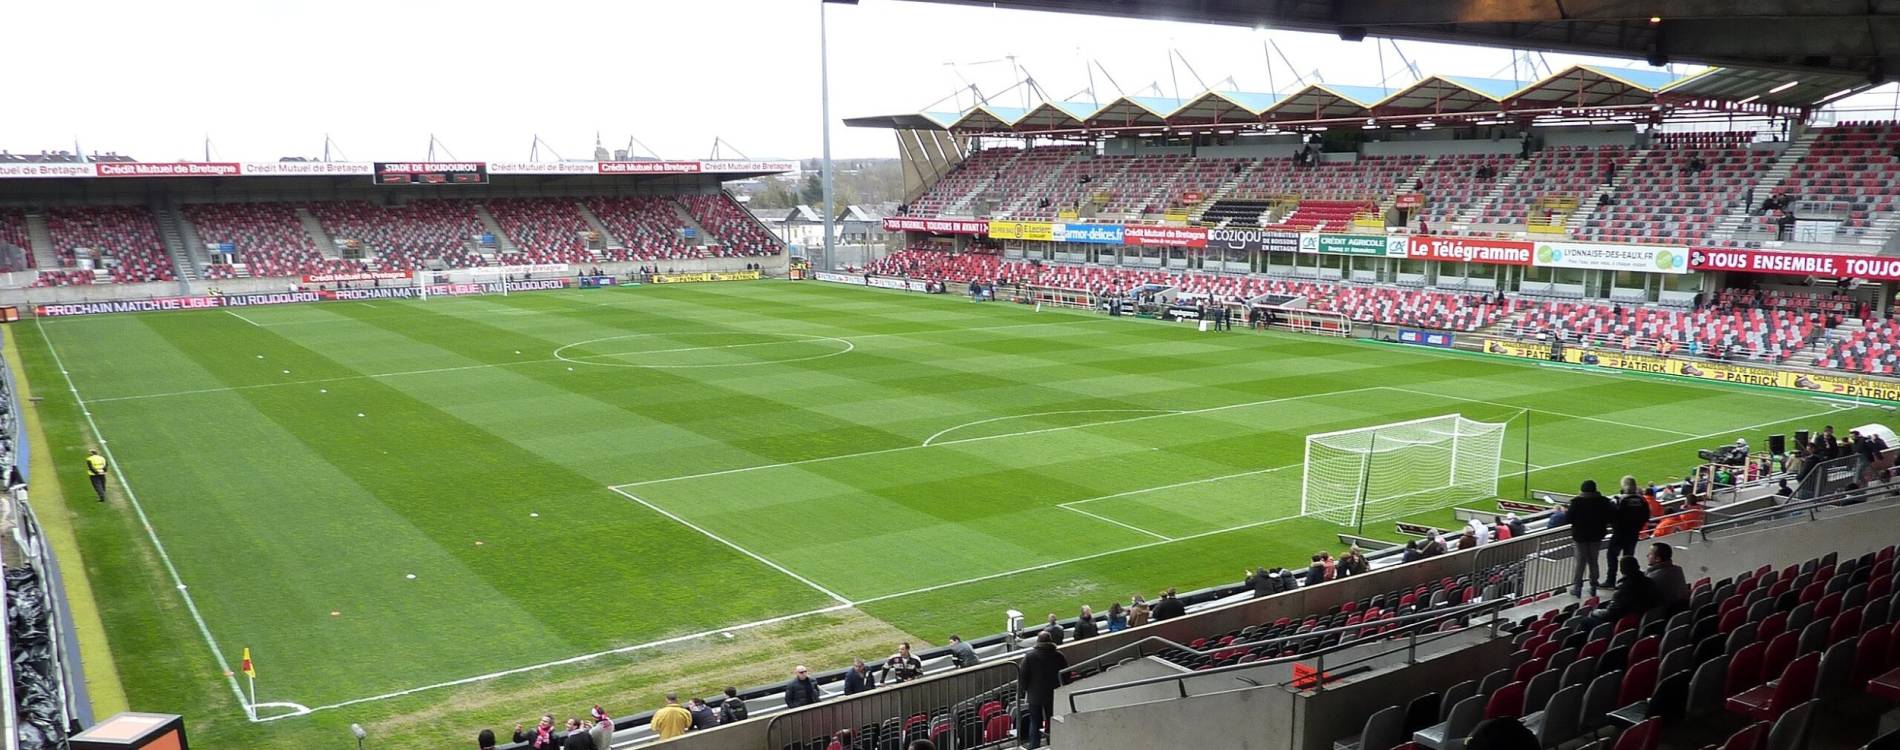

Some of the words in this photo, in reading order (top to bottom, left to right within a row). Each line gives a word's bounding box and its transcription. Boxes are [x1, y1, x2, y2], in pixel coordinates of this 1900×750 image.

[23, 166, 37, 175] de
[40, 165, 90, 176] Bretagne
[101, 164, 136, 174] Crédit
[137, 163, 173, 174] Mutuel
[174, 163, 188, 173] de
[190, 163, 236, 175] Bretagne
[247, 163, 278, 173] Crédit
[280, 163, 311, 173] Mutuel
[313, 163, 325, 172] de
[328, 163, 369, 174] Bretagne
[384, 163, 411, 172] STADE
[412, 163, 424, 172] DE
[426, 163, 477, 172] ROUDOUROU
[491, 163, 517, 172] Crédit
[518, 163, 545, 172] Mutuel
[547, 162, 558, 171] de
[559, 162, 594, 173] Bretagne
[601, 162, 626, 172] Crédit
[627, 162, 652, 172] Mutuel
[653, 162, 663, 171] de
[664, 162, 698, 172] Bretagne
[705, 162, 726, 171] Crédit
[728, 162, 751, 171] Mutuel
[752, 162, 761, 170] de
[762, 162, 793, 171] Bretagne
[1065, 228, 1123, 241] armor-delices.fr
[1124, 228, 1143, 237] Crédit
[1144, 228, 1165, 237] Mutuel
[1166, 229, 1175, 238] de
[1175, 230, 1205, 240] Bretagne
[1321, 236, 1346, 246] CRÉDIT
[1349, 238, 1385, 247] AGRICOLE
[1411, 241, 1429, 256] Le
[1432, 240, 1530, 262] Télégramme
[1564, 249, 1654, 260] LYONNAISE-DES-EAUX.FR
[1708, 253, 1747, 269] TOUS
[1753, 255, 1838, 275] ENSEMBLE,
[1846, 259, 1900, 277] TOUJO
[335, 288, 391, 301] PROCHAIN
[393, 286, 432, 299] MATCH
[433, 285, 448, 295] DE
[448, 284, 480, 295] LIGUE
[488, 283, 503, 293] AU
[505, 280, 563, 293] ROUDOUROU
[46, 301, 112, 316] PROCHAIN
[114, 299, 160, 313] MATCH
[162, 299, 180, 310] DE
[181, 297, 219, 309] LIGUE
[222, 297, 227, 307] 1
[229, 295, 247, 306] AU
[249, 291, 320, 305] ROUDOUROU
[1526, 350, 1567, 363] PATRK
[1620, 360, 1666, 373] PATRICK
[1727, 372, 1779, 387] PATRICK
